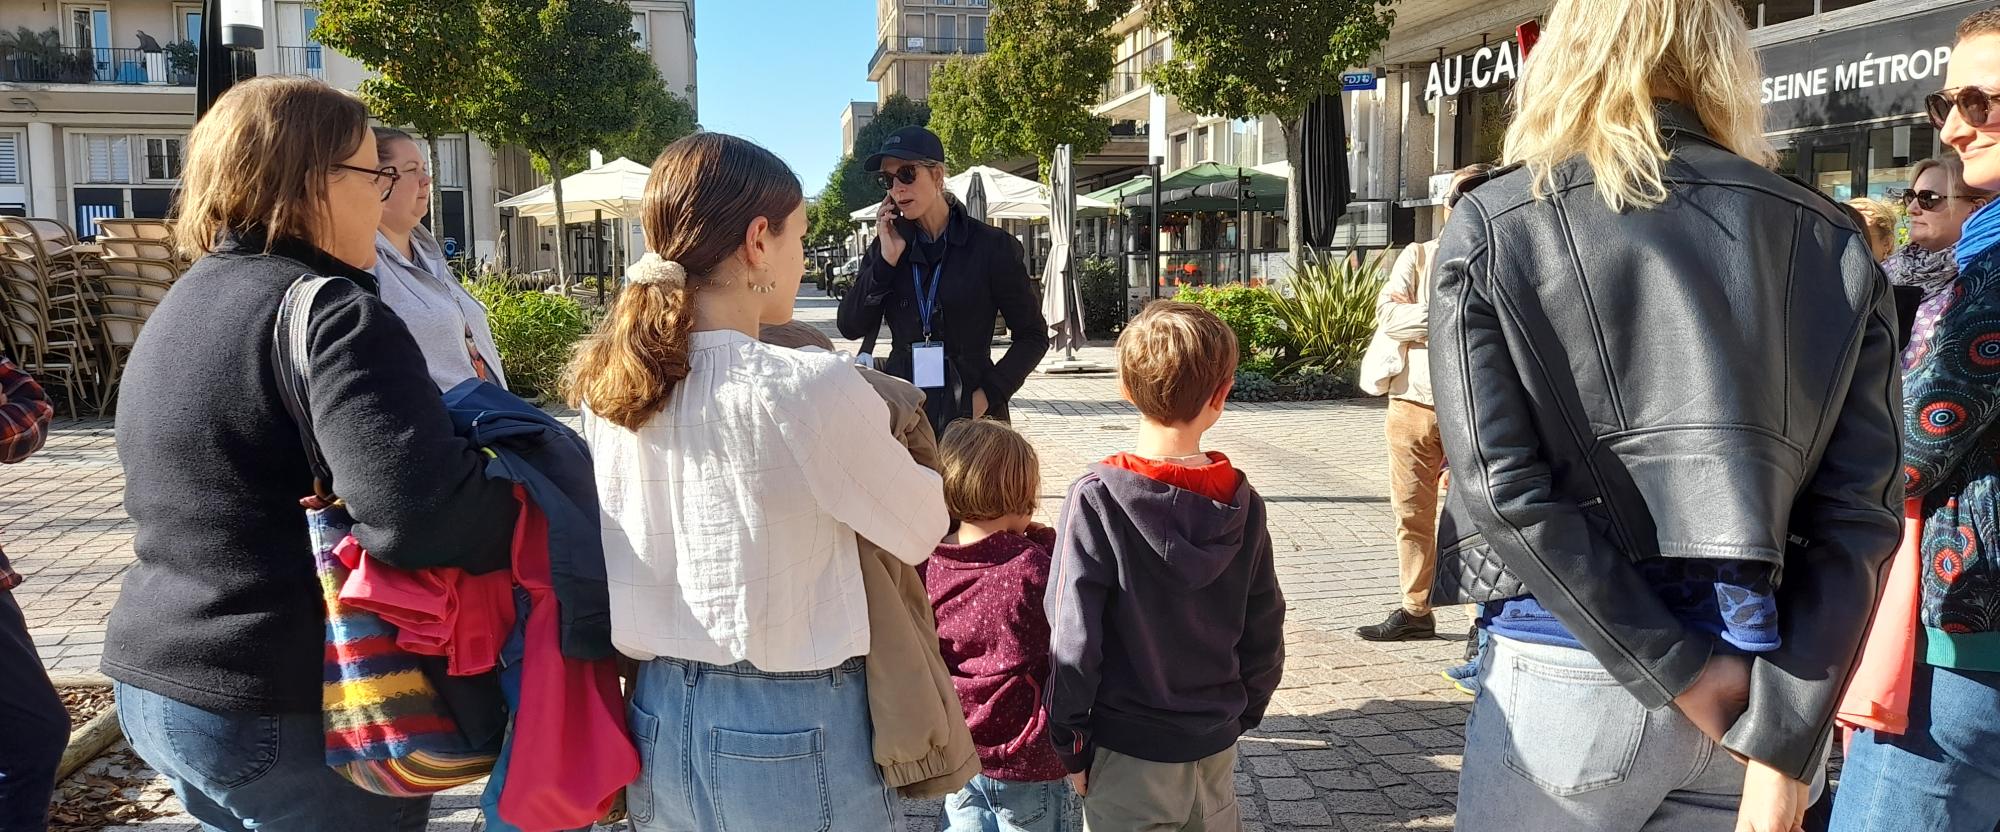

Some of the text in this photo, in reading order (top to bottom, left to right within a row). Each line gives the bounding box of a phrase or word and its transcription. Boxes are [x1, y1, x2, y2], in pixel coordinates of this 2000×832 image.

[1424, 54, 1463, 101] AU
[1760, 46, 1951, 104] SEINE MÉTROP
